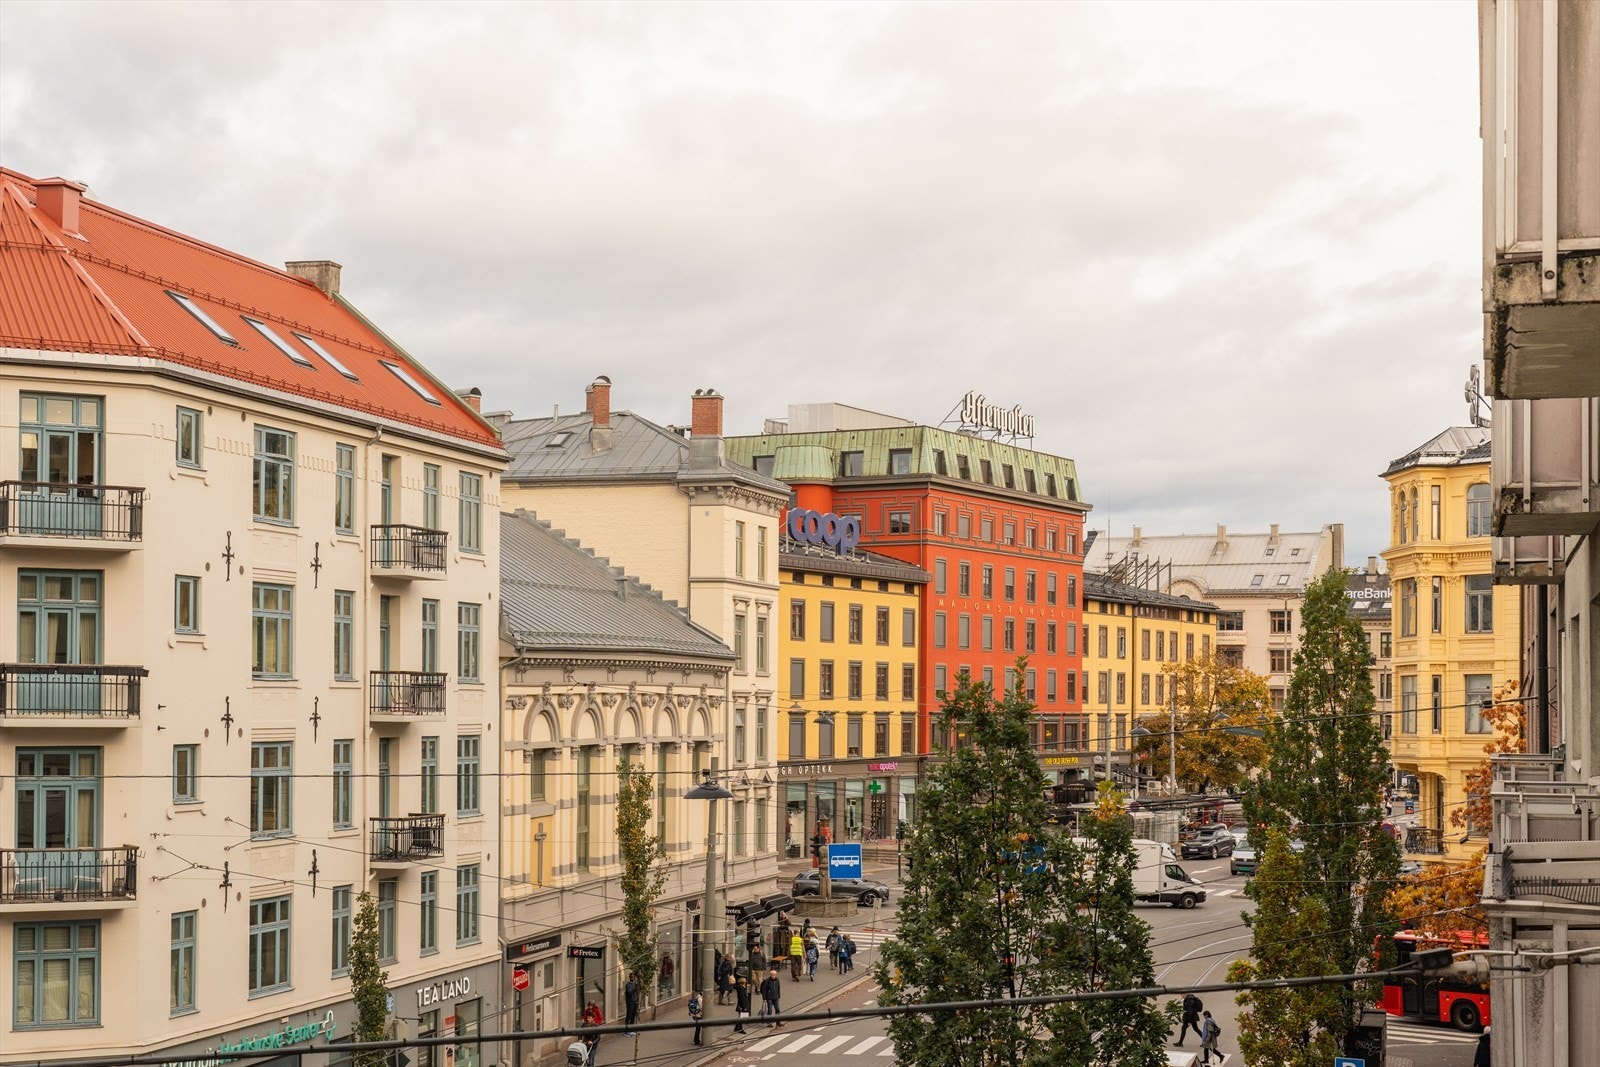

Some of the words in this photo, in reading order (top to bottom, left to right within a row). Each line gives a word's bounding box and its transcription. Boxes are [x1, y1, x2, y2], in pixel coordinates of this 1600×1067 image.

[788, 507, 859, 556] coop
[1344, 588, 1392, 599] areBank
[939, 598, 1074, 619] MAJORSTUHUSET
[1053, 757, 1061, 765] OLD
[778, 765, 792, 775] GH
[798, 764, 833, 775] OPTIKK
[579, 949, 599, 957] Fretex
[417, 986, 439, 1007] TEA
[442, 976, 470, 1001] LAND
